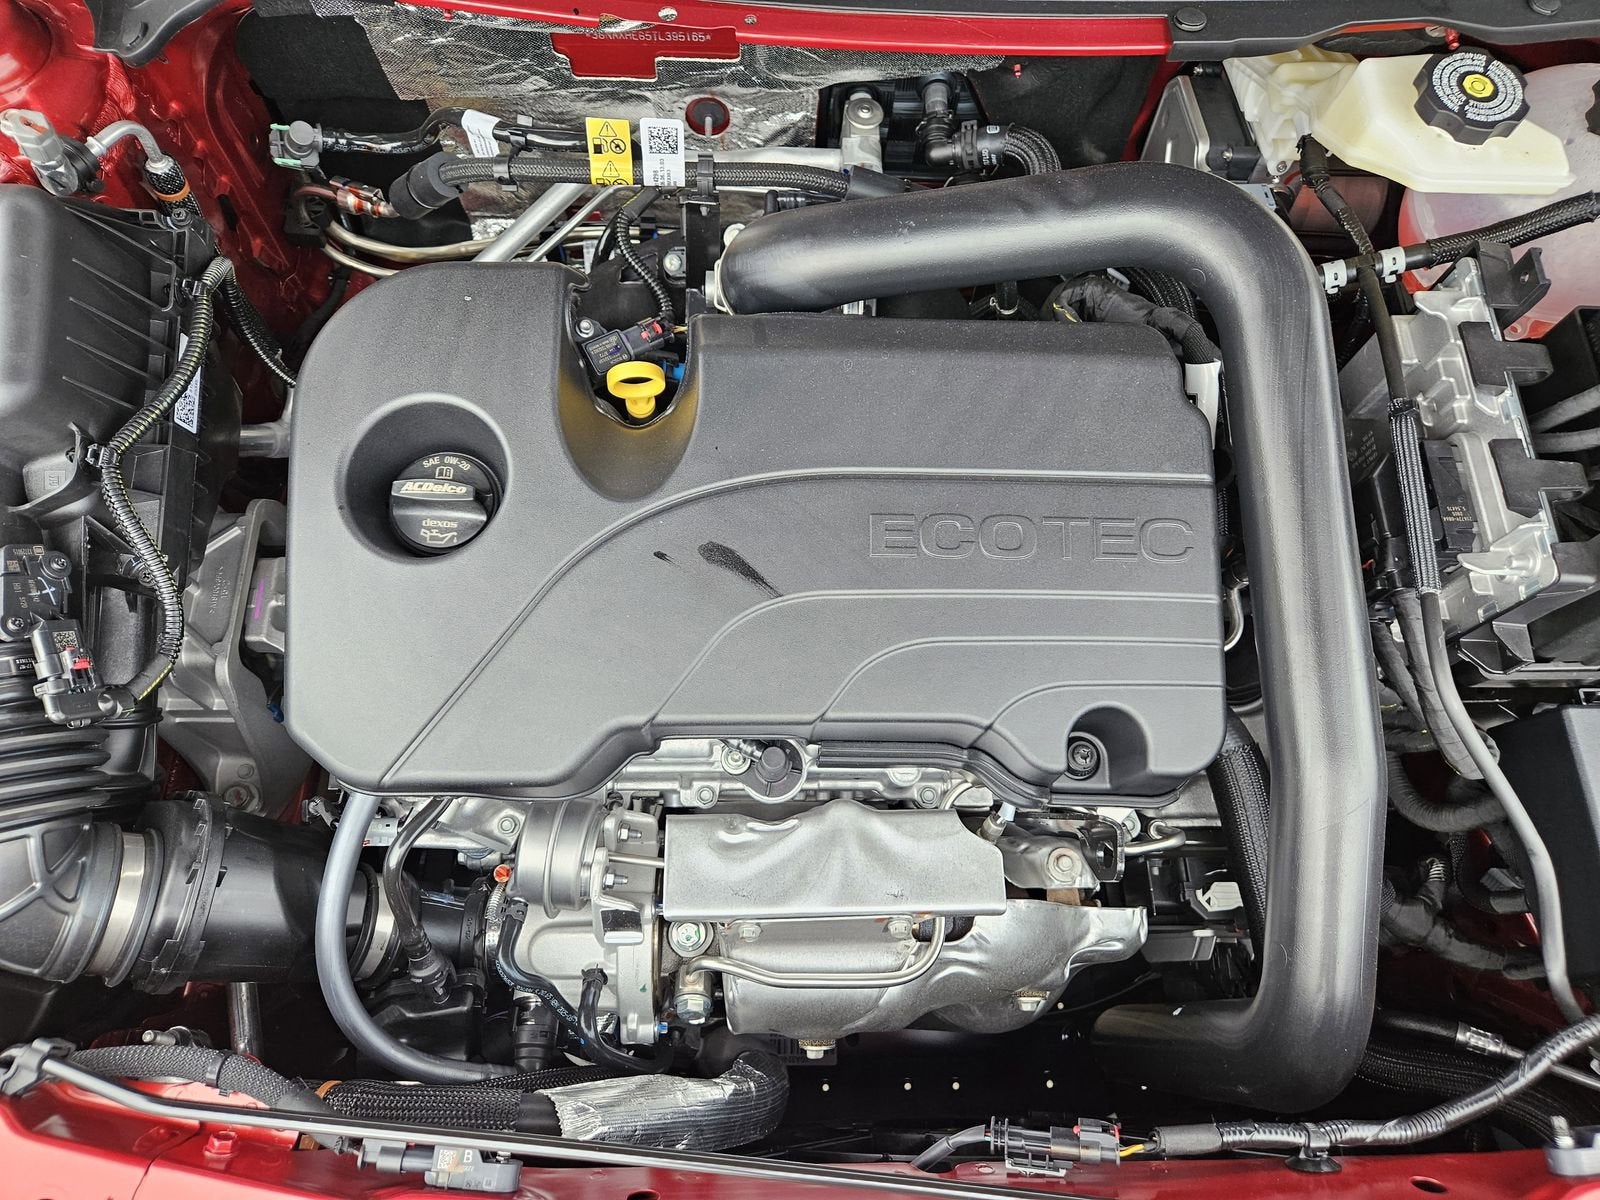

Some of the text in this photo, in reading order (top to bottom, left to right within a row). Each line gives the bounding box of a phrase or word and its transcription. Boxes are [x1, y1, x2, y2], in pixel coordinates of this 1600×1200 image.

[423, 456, 471, 471] SAE 0W-20
[400, 481, 467, 494] ACDelco
[422, 518, 458, 528] dexos
[869, 512, 1194, 564] ECOTEC
[464, 1150, 473, 1163] B
